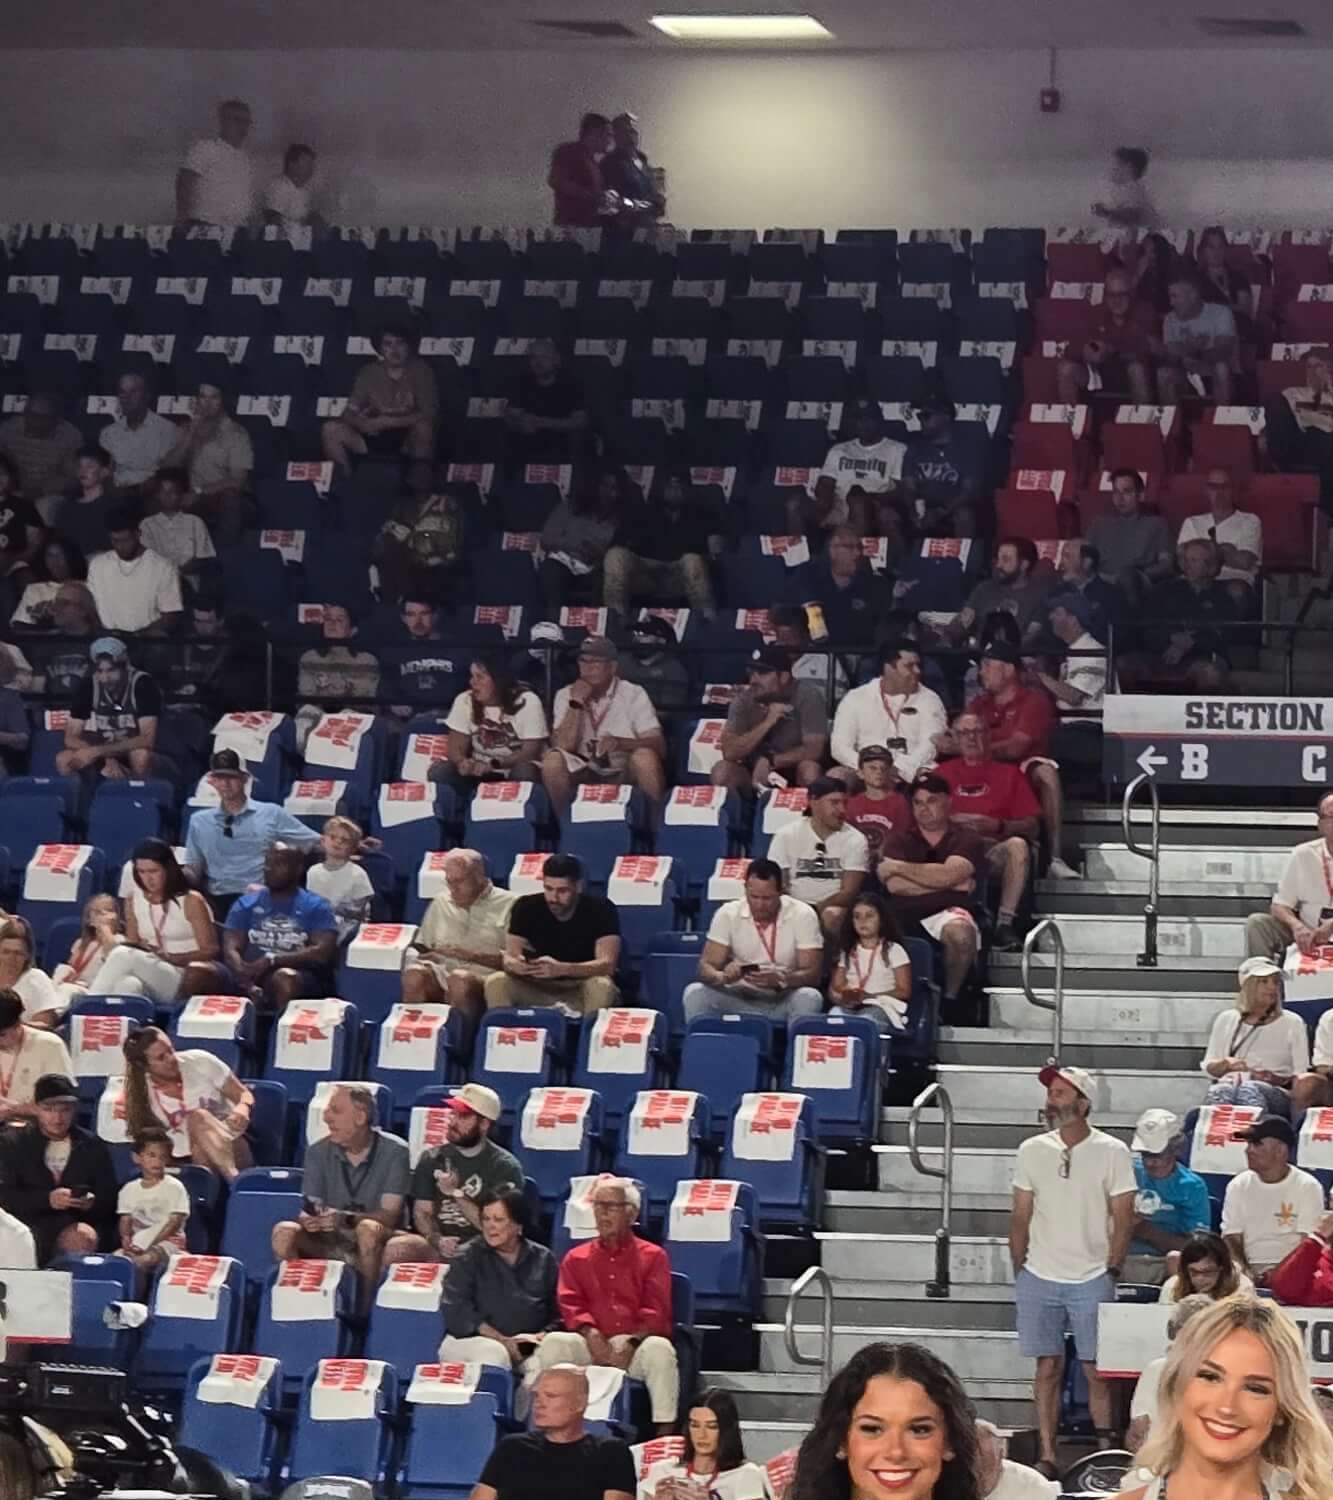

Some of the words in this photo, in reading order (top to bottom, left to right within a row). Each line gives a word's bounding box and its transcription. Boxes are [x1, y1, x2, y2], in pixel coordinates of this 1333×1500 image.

[1185, 702, 1325, 731] SECTION
[1180, 743, 1208, 780] B
[1301, 745, 1327, 782] C
